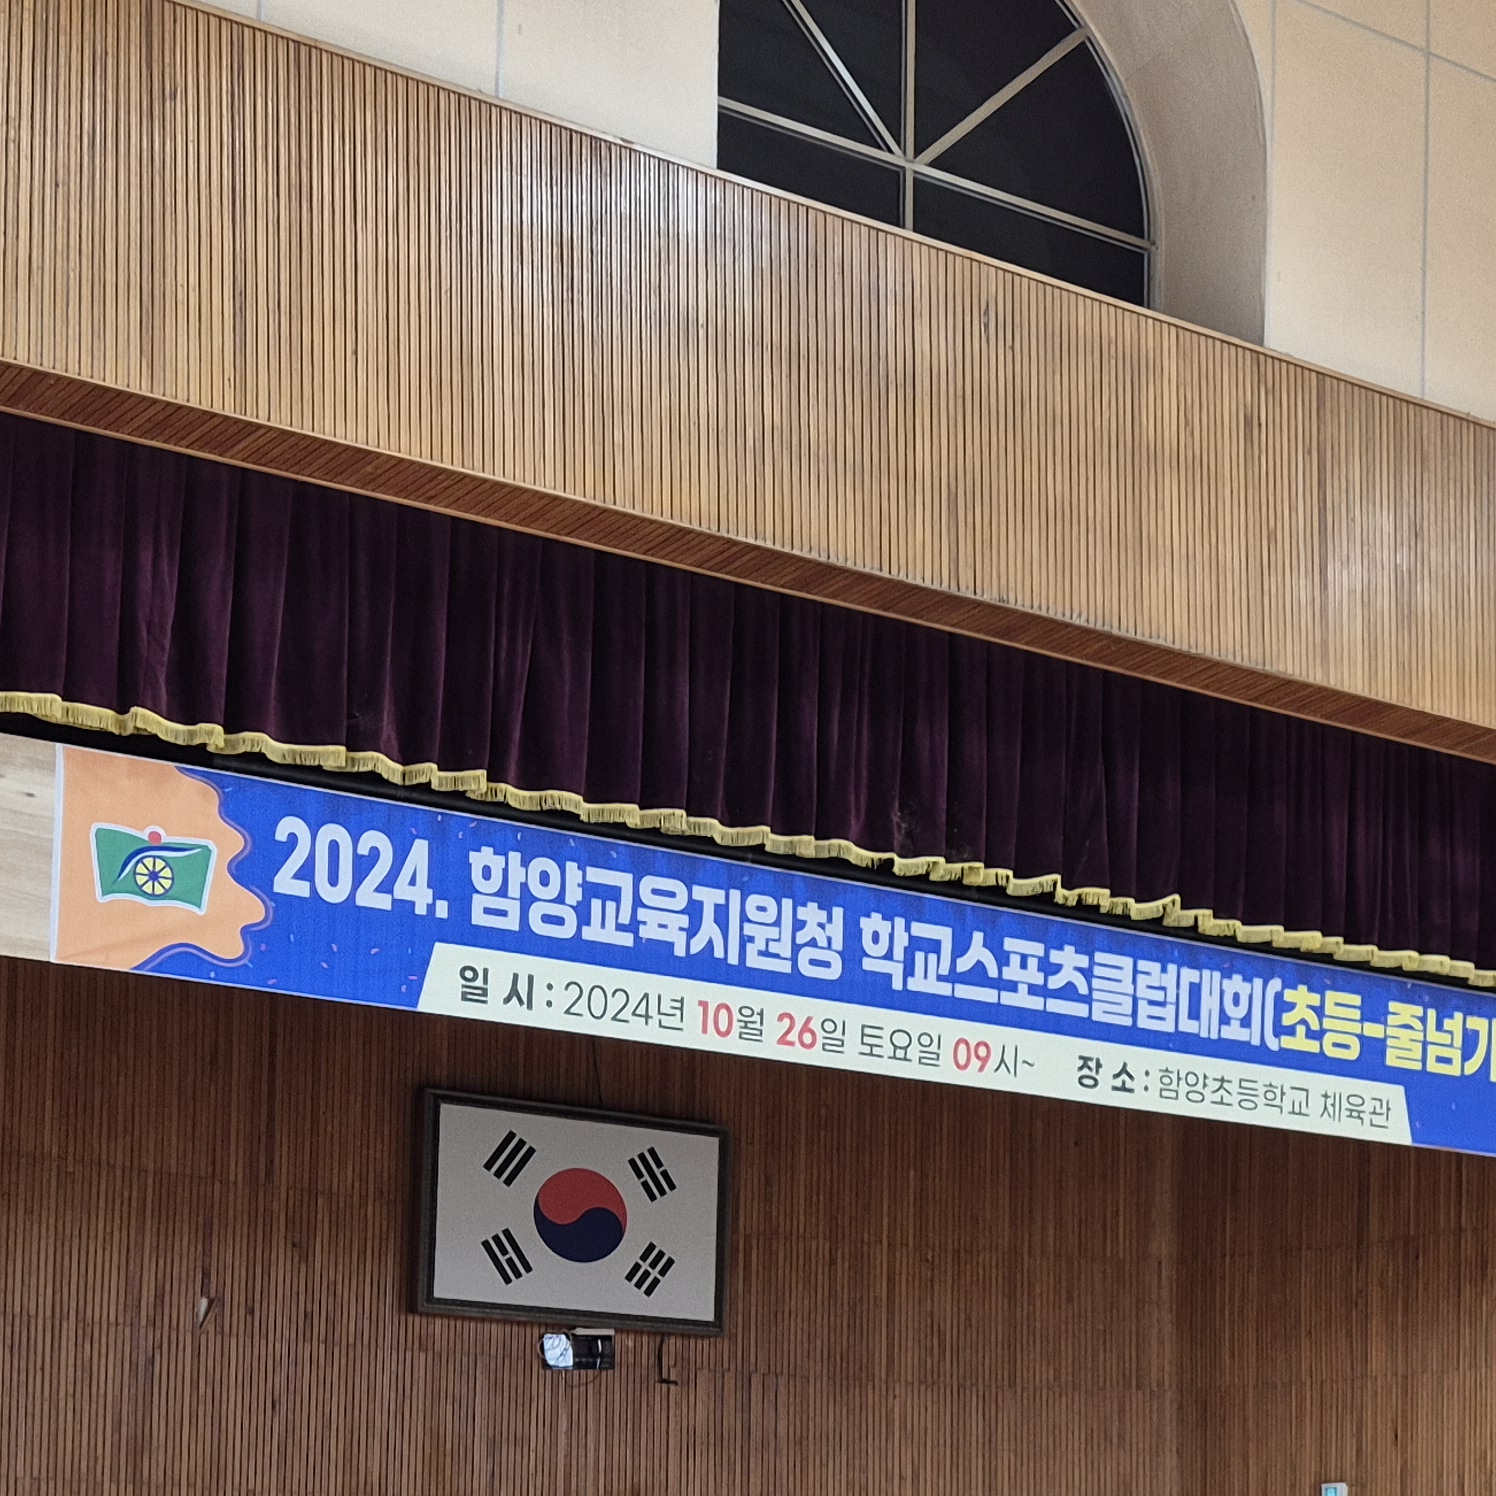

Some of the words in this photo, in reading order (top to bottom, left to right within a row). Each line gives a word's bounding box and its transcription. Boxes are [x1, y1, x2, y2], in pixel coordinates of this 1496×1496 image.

[273, 815, 448, 919] 2024.
[469, 846, 843, 980] 함양교육지원청
[563, 981, 684, 1031] 2024년
[697, 1000, 765, 1043] 10월
[776, 1012, 846, 1054] 26일
[858, 1024, 942, 1067] 토요일
[952, 1037, 1036, 1078] 09시~
[1158, 1066, 1310, 1117] 함양초등학교
[1320, 1089, 1391, 1129] 체육관
